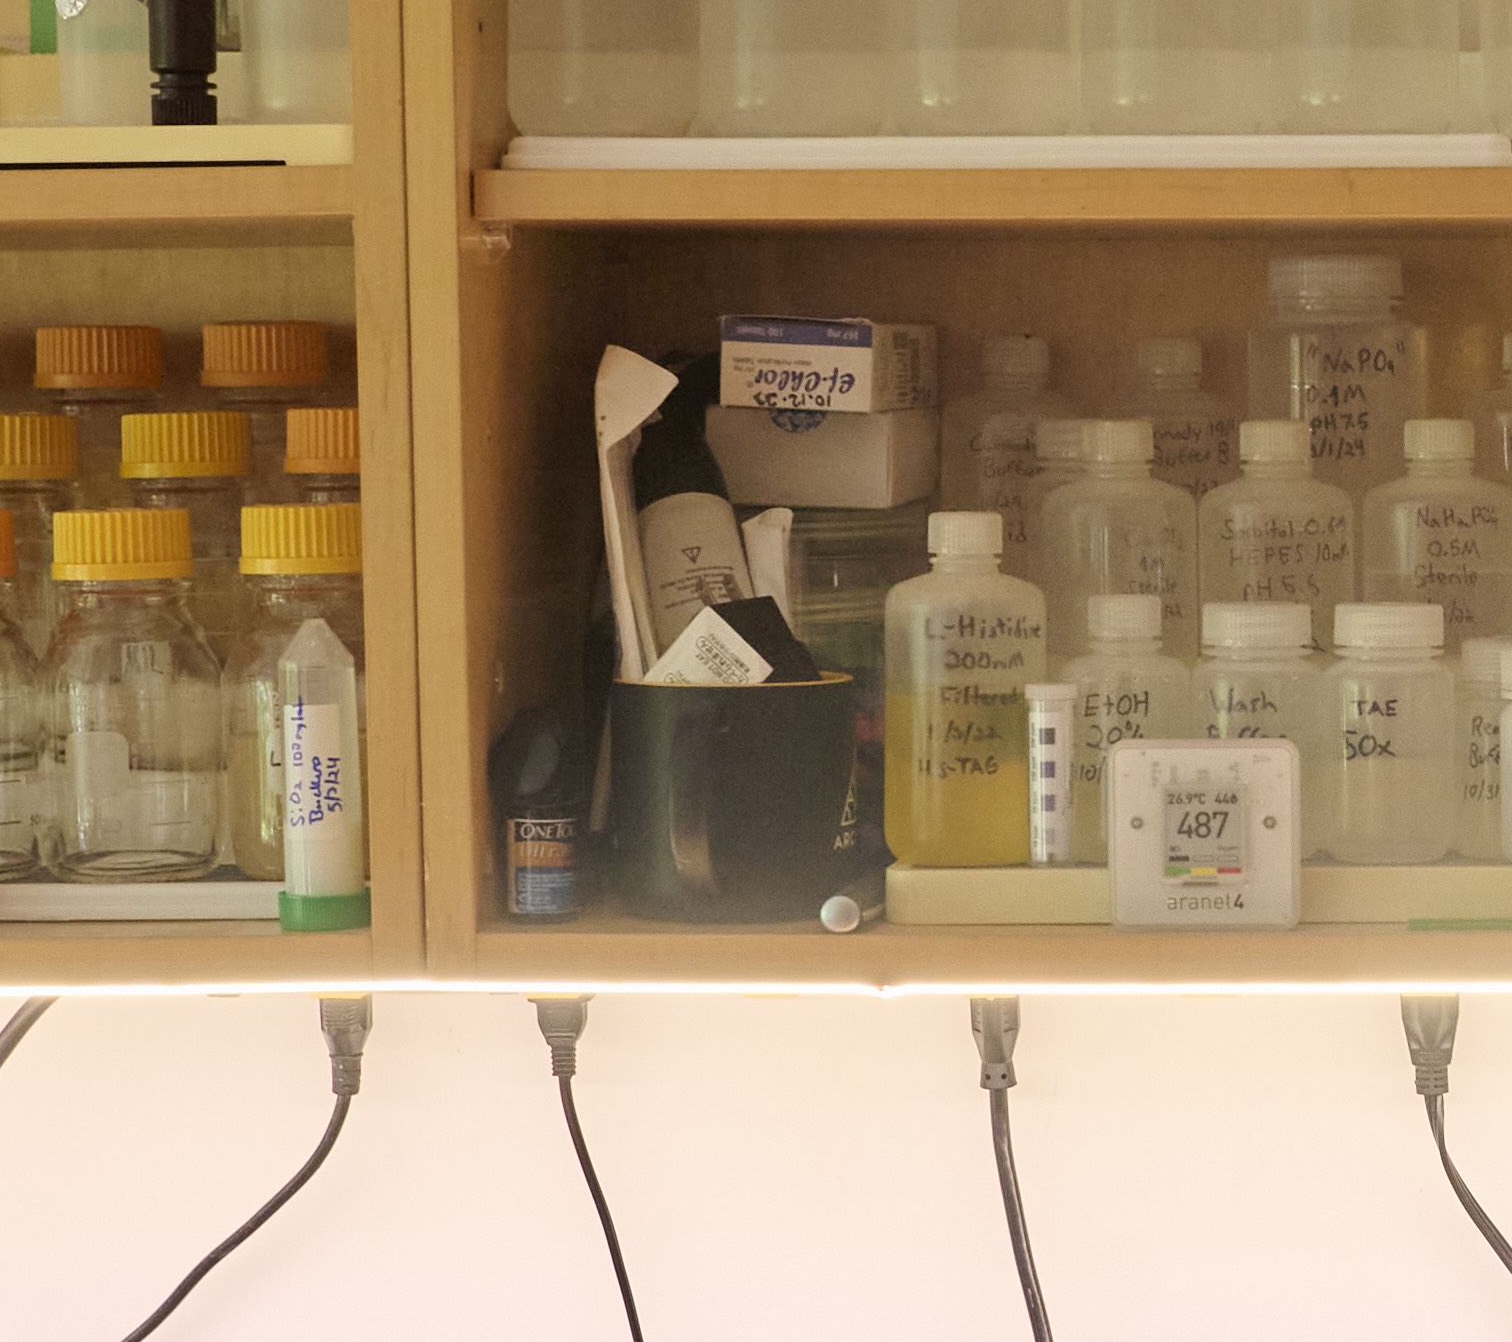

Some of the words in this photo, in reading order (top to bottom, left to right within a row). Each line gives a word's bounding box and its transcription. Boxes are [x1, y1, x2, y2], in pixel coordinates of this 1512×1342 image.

[1084, 692, 1150, 718] EtOH
[1210, 690, 1278, 715] Wash
[1353, 698, 1400, 718] TAE
[1177, 812, 1229, 839] 487
[1166, 893, 1244, 911] aranet4
